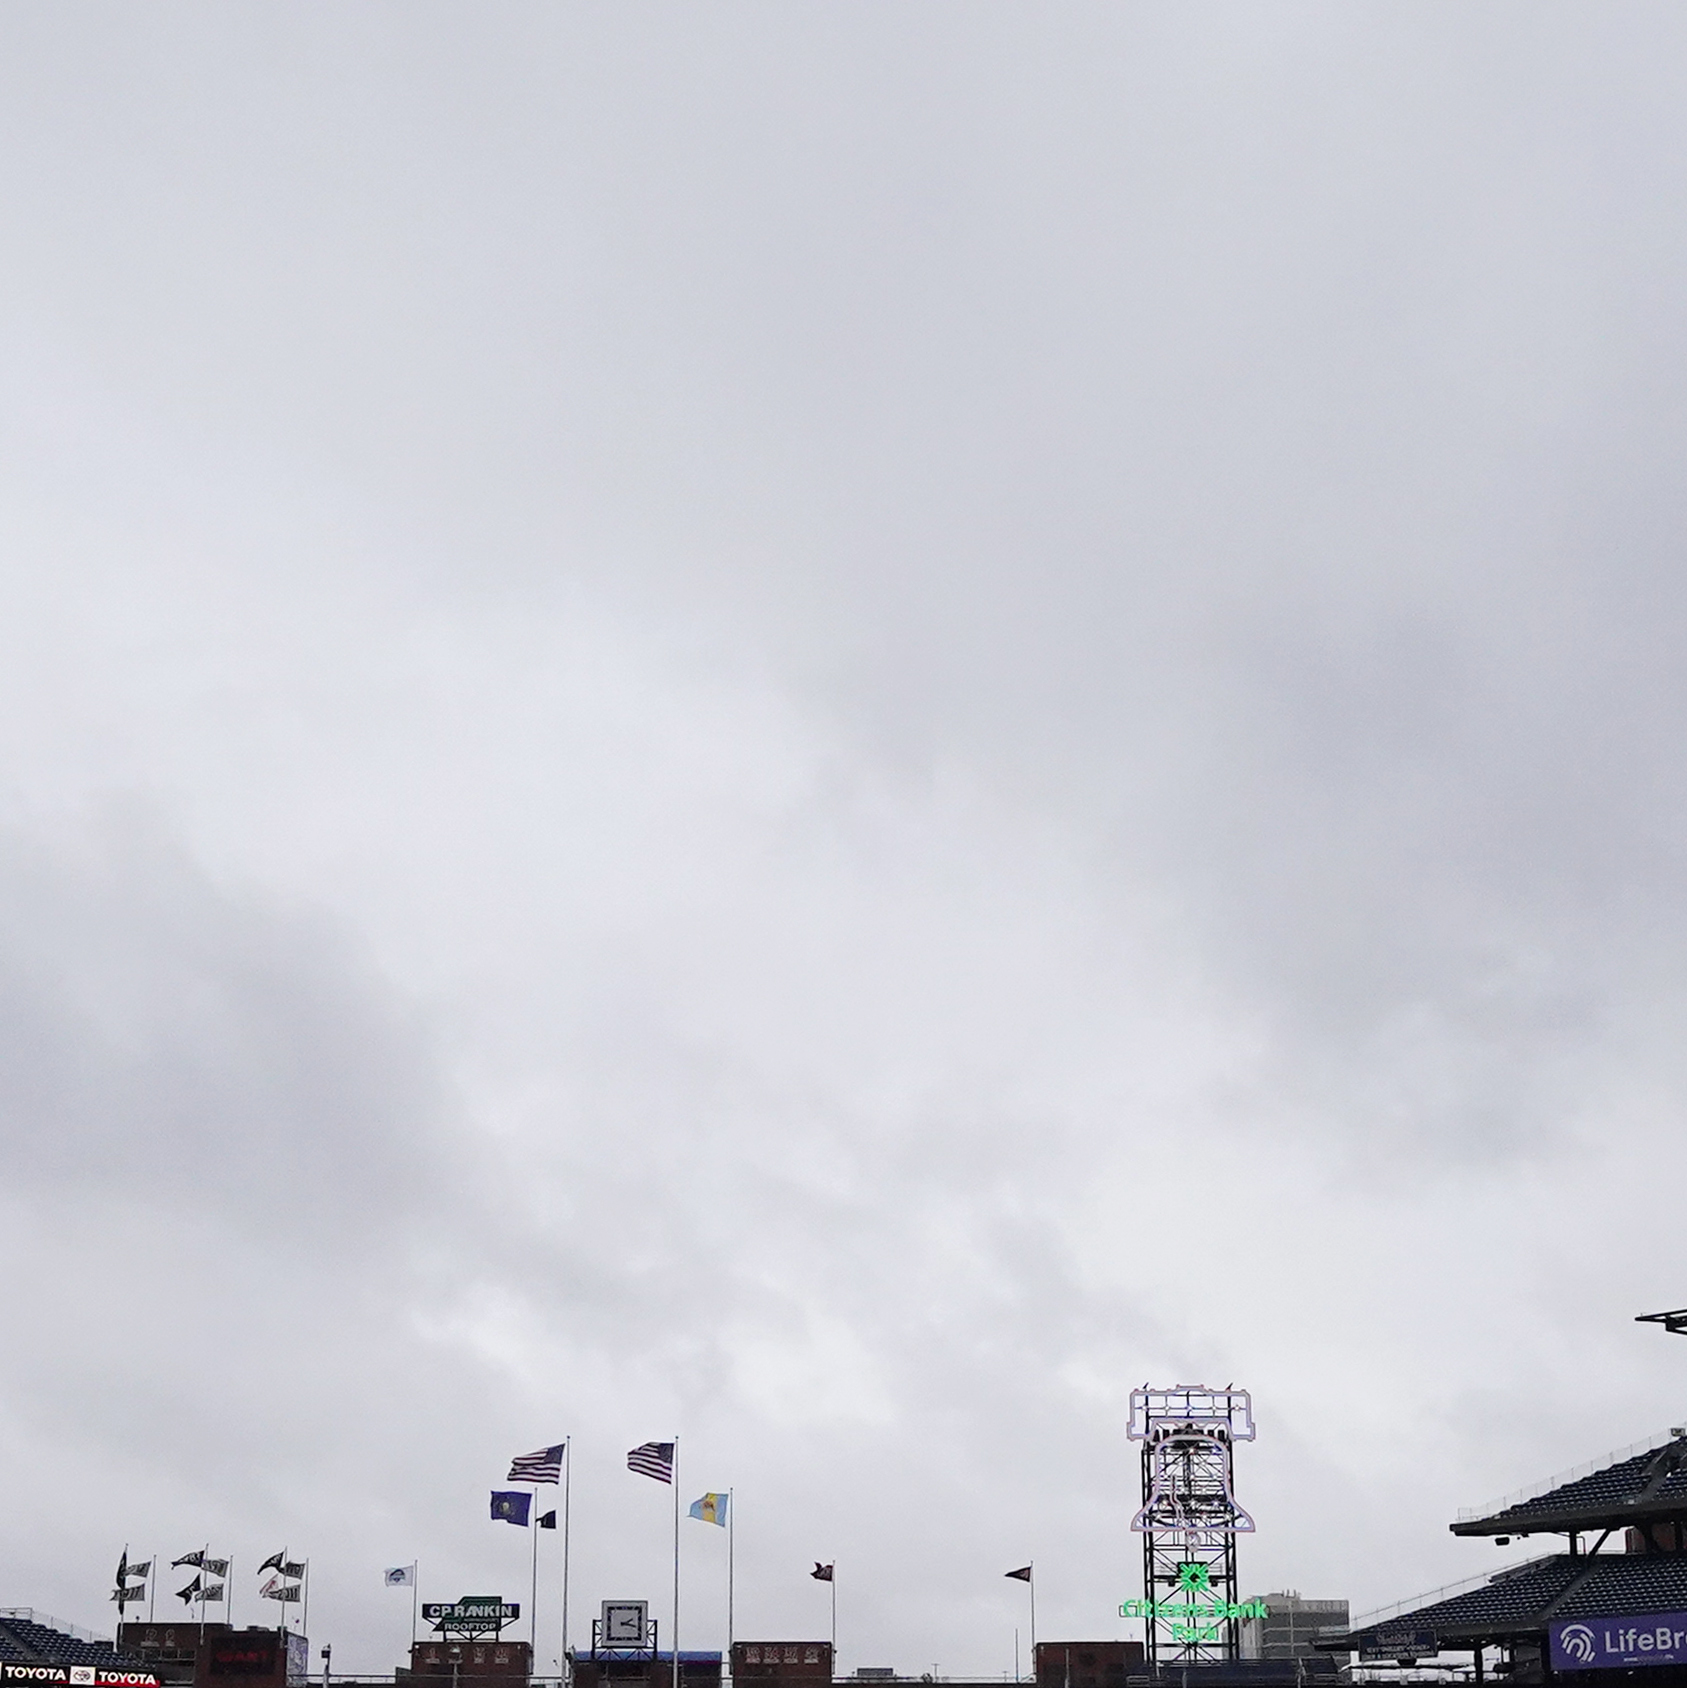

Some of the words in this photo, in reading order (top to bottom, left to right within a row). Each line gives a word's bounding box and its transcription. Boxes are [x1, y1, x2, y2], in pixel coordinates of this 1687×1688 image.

[454, 1605, 514, 1617] RANKIN
[443, 1622, 497, 1631] ROOFTOP
[4, 1665, 68, 1681] TOYOTA
[98, 1671, 157, 1686] TOYOTA
